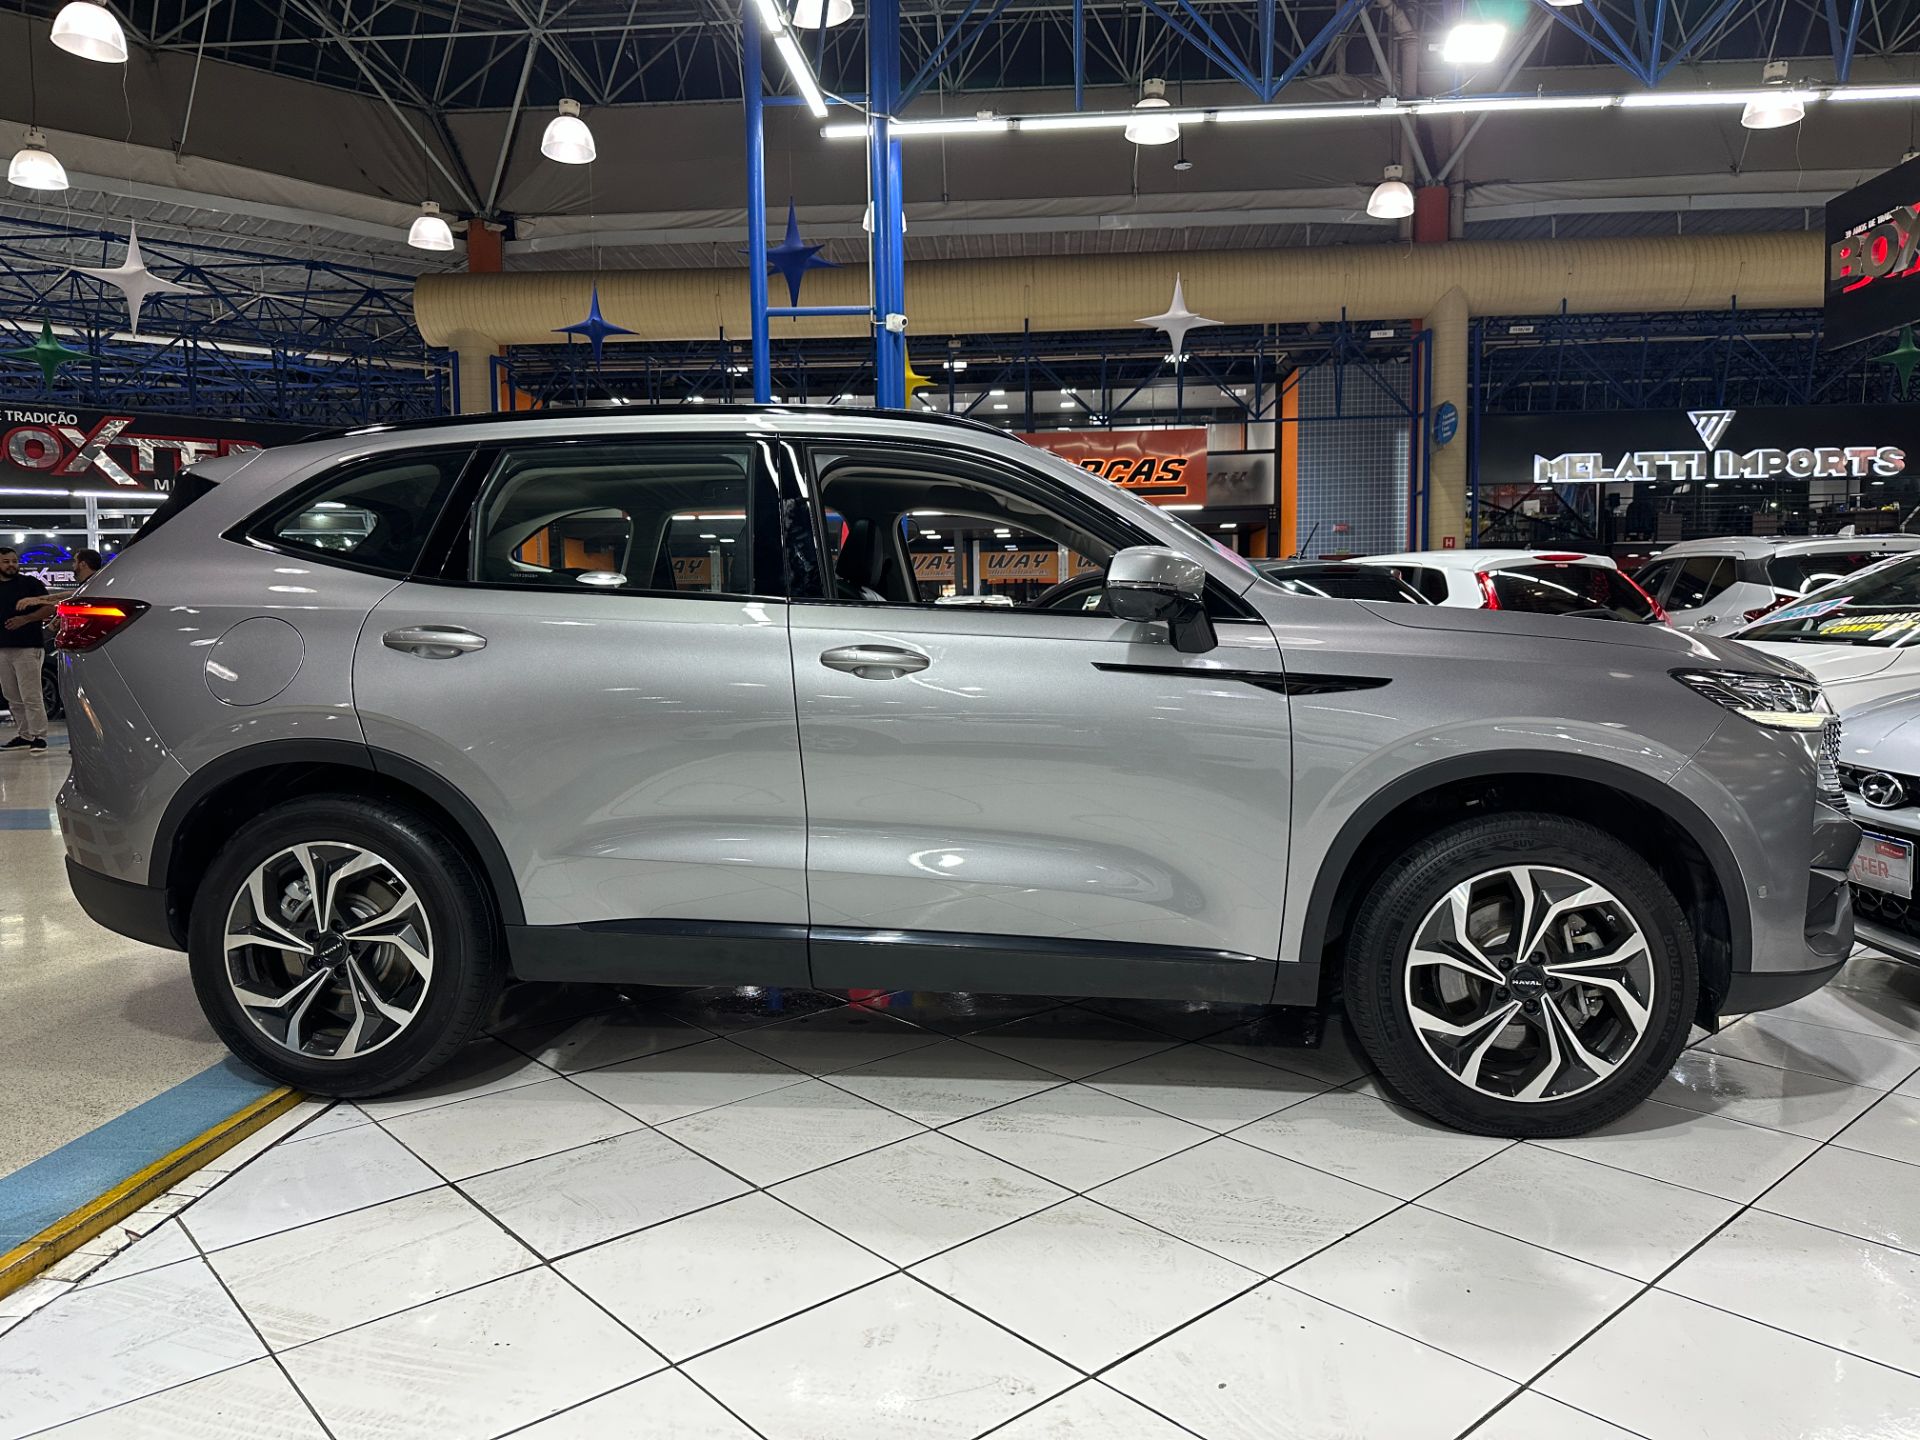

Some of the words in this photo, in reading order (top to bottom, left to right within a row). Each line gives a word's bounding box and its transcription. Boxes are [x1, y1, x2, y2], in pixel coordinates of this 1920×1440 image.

[5, 409, 78, 427] TRADIÇÃO
[0, 416, 262, 487] OXTE
[1534, 451, 1707, 483] MELATTI
[1714, 447, 1906, 478] IMPORTS
[988, 554, 1048, 569] WAY
[1512, 839, 1535, 848] SUV
